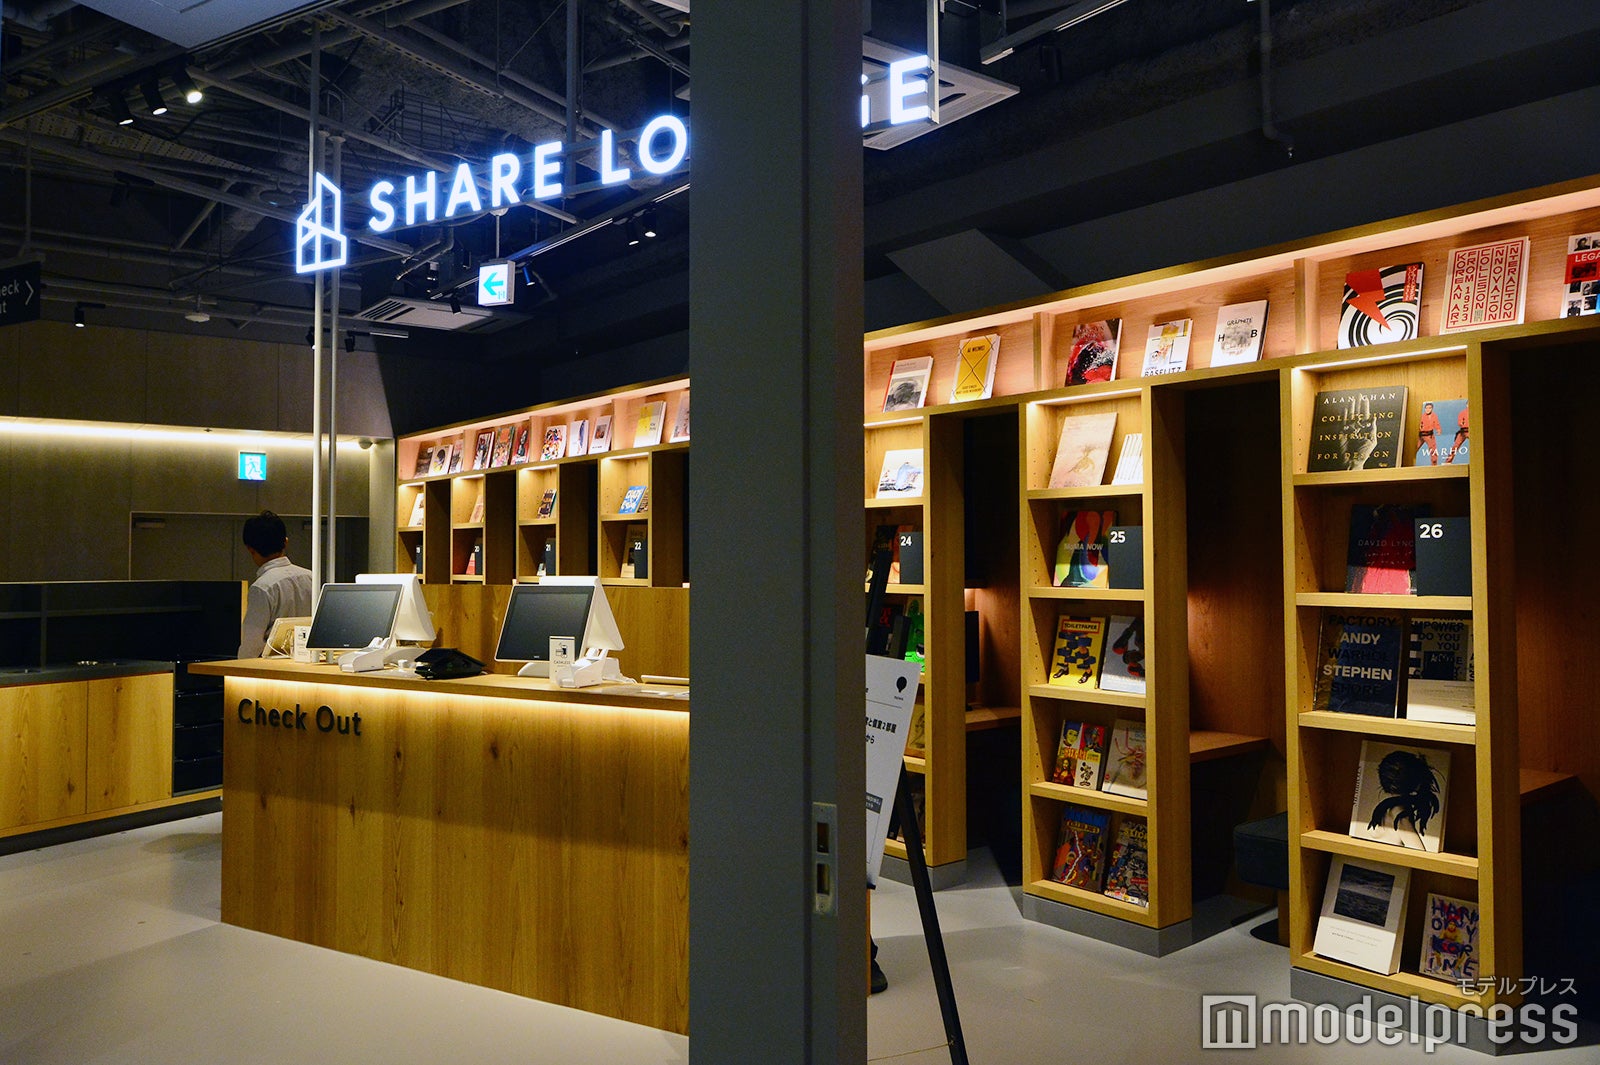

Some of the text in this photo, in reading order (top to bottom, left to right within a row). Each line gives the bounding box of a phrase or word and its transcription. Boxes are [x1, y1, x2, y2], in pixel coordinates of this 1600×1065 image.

[368, 140, 563, 233] SHARE
[1453, 252, 1467, 300] KOREAN
[0, 279, 20, 297] eck
[1462, 286, 1471, 322] 1953
[1323, 394, 1355, 405] ALAN
[1316, 449, 1339, 460] FOR
[1110, 530, 1126, 543] 25
[1419, 523, 1444, 539] 26
[634, 541, 642, 551] 22
[900, 535, 912, 547] 24
[1086, 543, 1104, 551] NOW
[1328, 615, 1397, 627] FACTORY
[1340, 631, 1382, 645] ANDY
[1322, 664, 1393, 681] STEPHEN
[238, 697, 362, 736] Check Out
